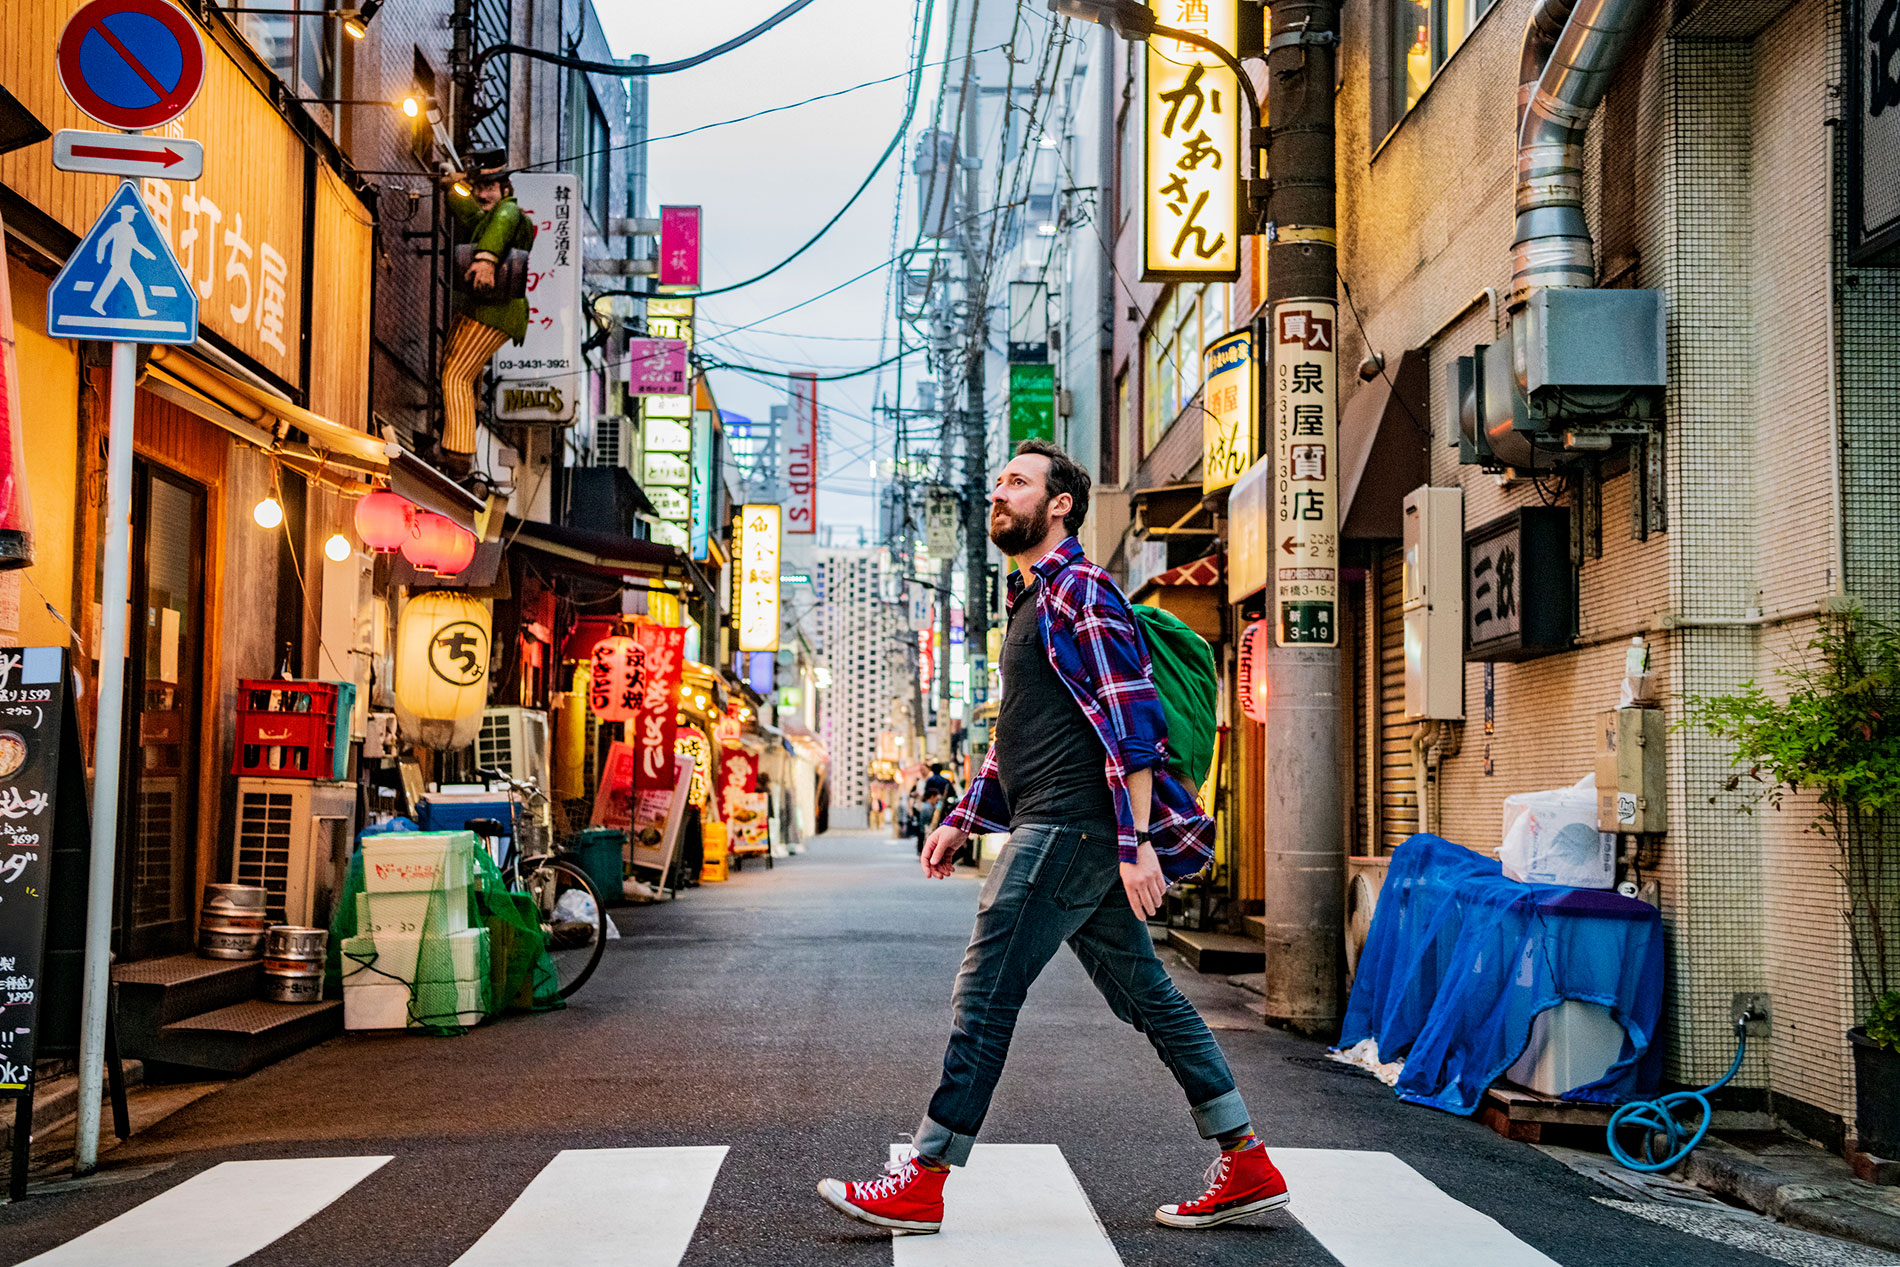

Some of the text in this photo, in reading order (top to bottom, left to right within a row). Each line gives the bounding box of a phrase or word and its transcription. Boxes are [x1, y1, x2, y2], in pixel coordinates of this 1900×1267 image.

[1158, 61, 1226, 260] かぁさん
[553, 185, 570, 267] 韓国居酒屋
[1284, 315, 1330, 348] 買入
[499, 360, 569, 370] 03-3431-3921
[1290, 626, 1328, 639] 3-19
[592, 646, 613, 710] やきとり
[621, 647, 645, 710] 炭火焼
